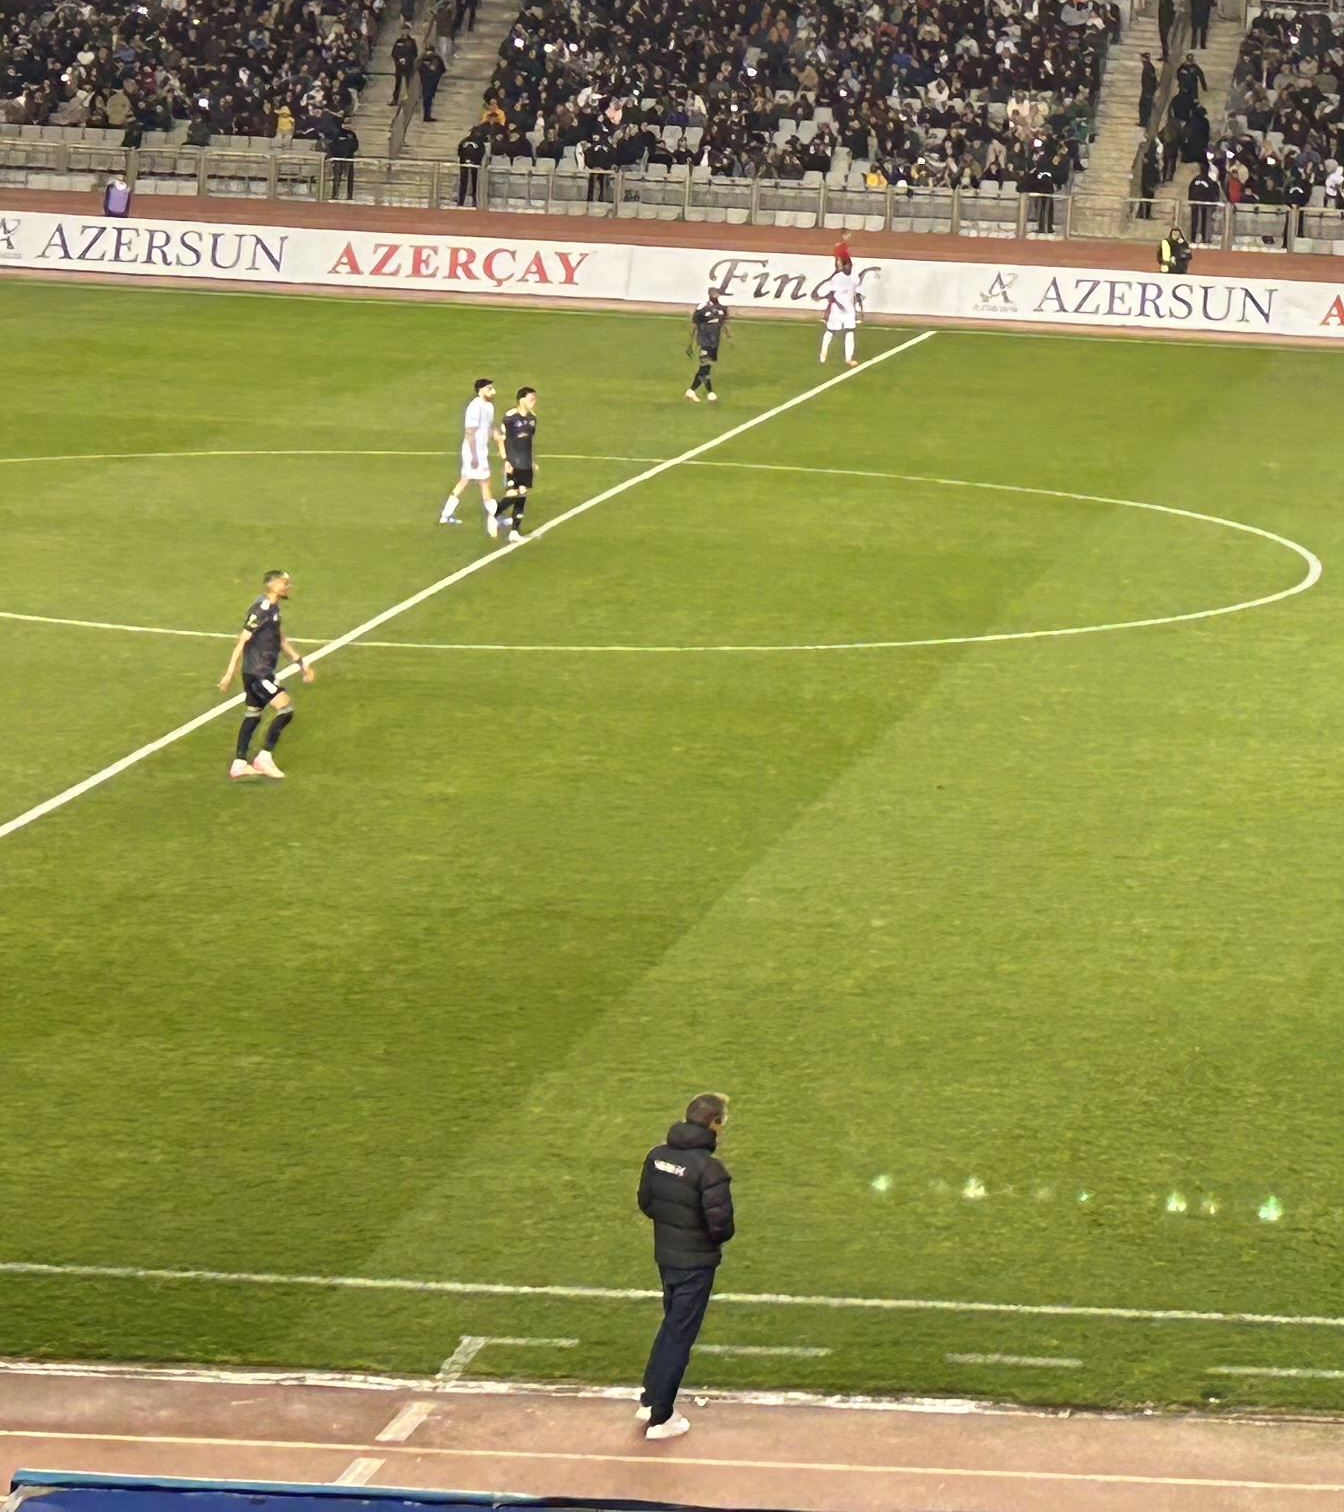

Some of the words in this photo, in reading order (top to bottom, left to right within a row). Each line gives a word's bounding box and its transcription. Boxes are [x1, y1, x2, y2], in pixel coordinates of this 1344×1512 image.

[35, 223, 289, 272] AZERSUN
[326, 241, 590, 288] AZERÇAY
[1032, 276, 1279, 324] AZERSUN
